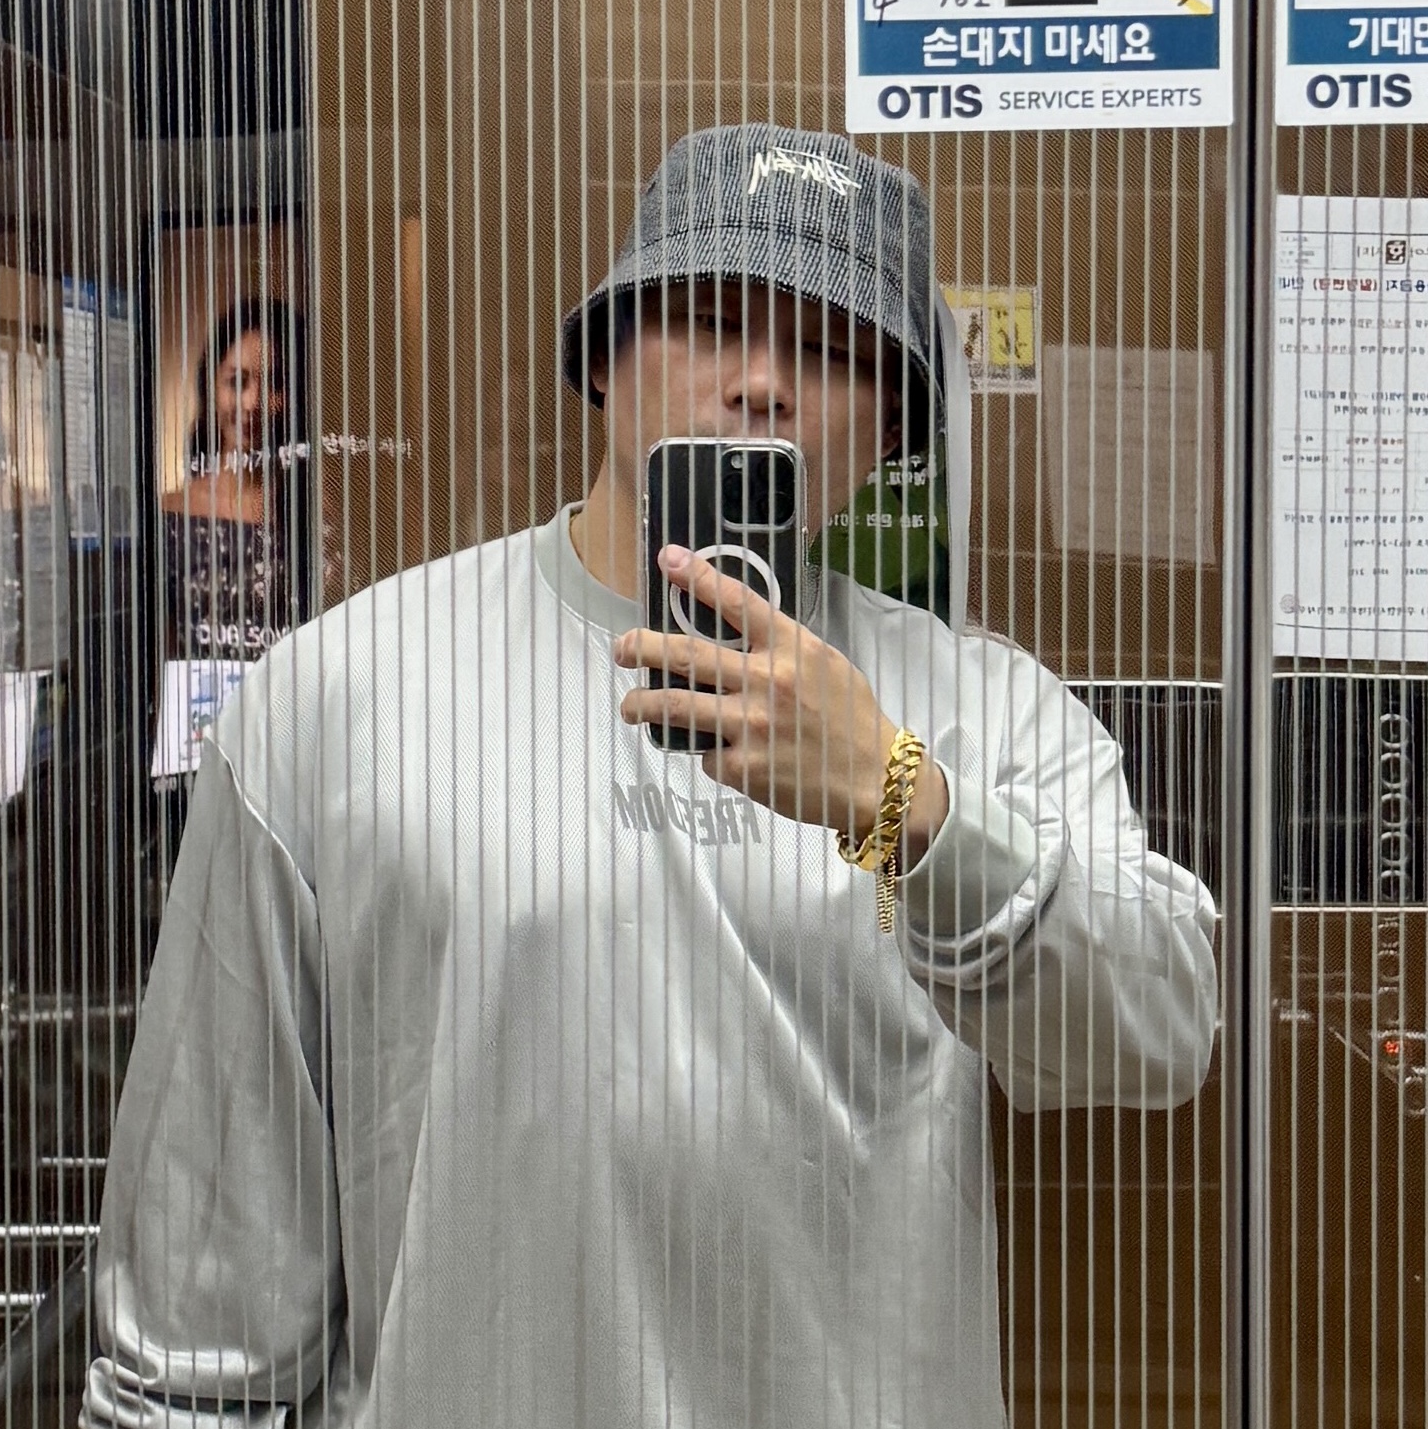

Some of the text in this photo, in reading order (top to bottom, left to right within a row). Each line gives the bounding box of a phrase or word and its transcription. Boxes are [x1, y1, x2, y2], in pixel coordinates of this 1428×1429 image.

[922, 21, 1156, 68] 손대지 마세요
[878, 84, 1203, 121] OTIS SERVICE EXPERTS
[1306, 74, 1412, 110] OTIS
